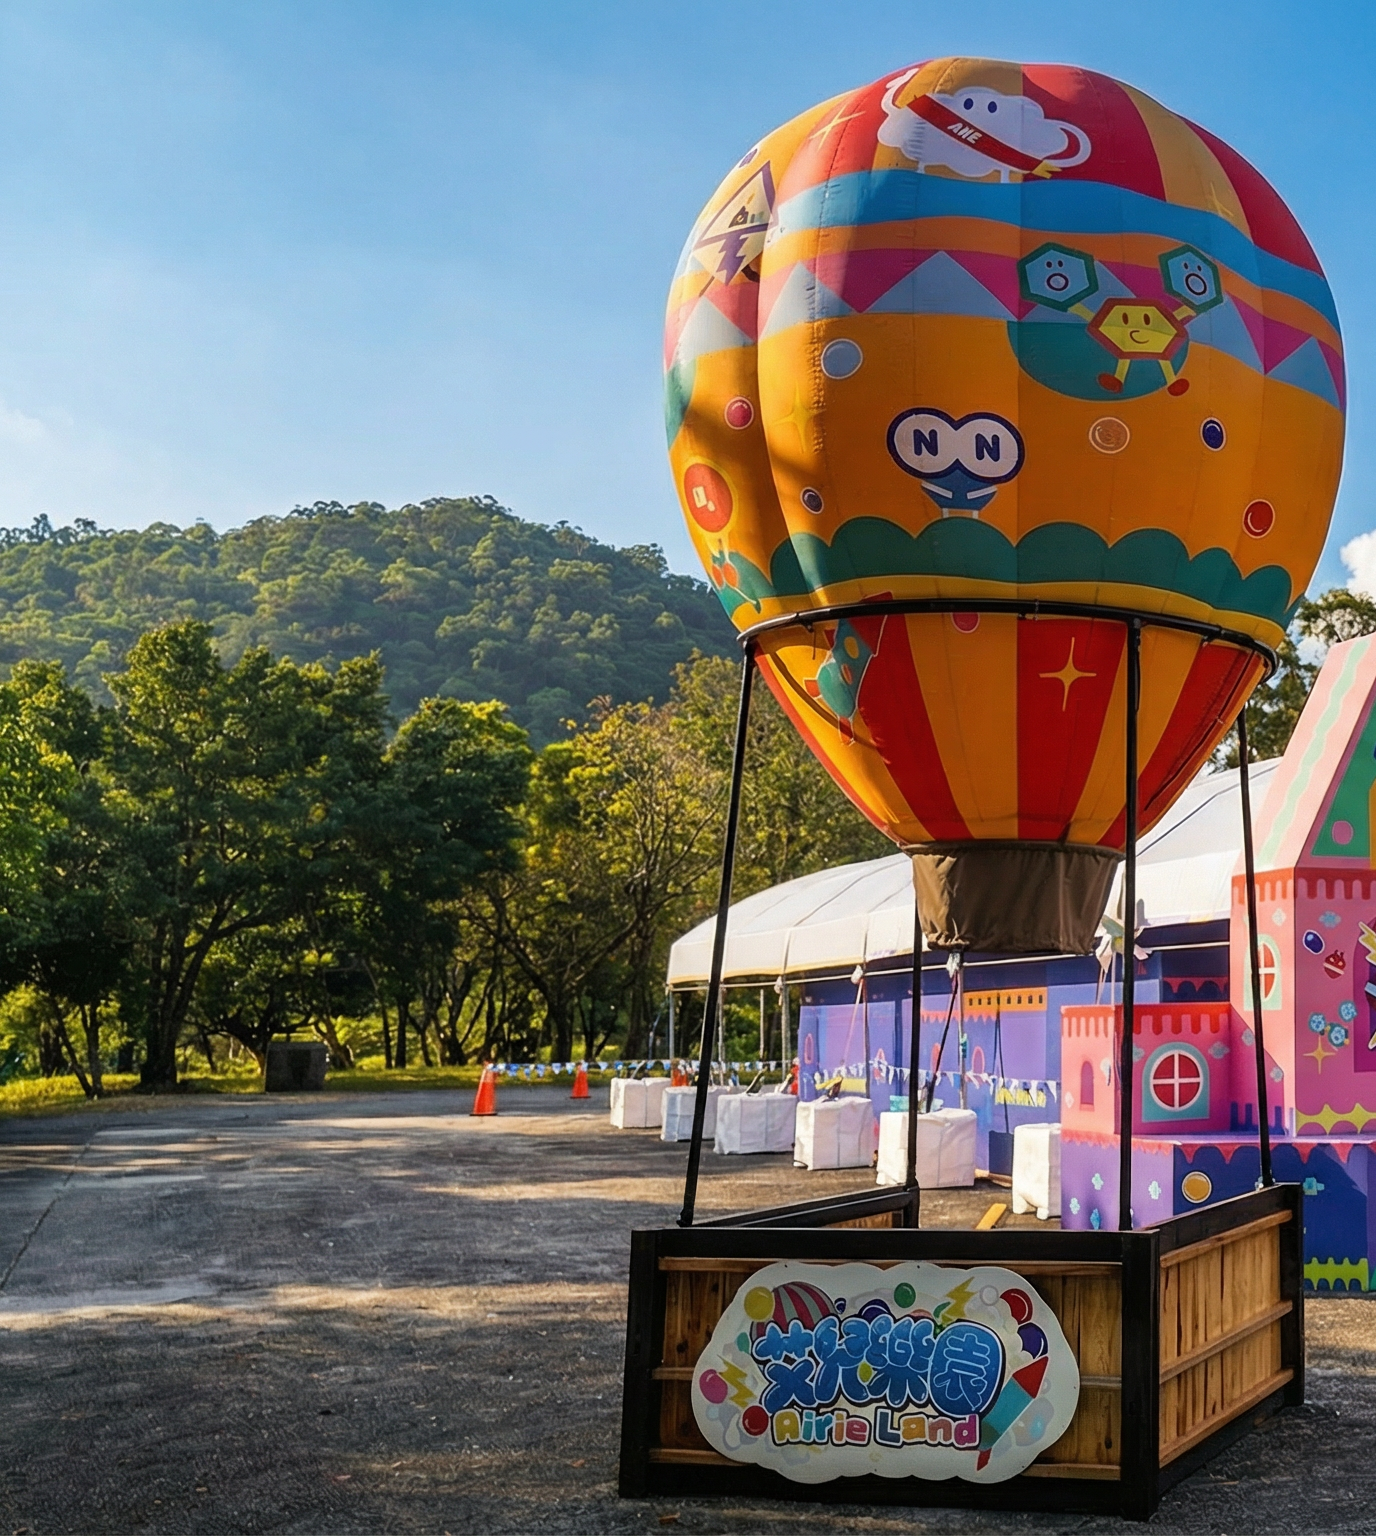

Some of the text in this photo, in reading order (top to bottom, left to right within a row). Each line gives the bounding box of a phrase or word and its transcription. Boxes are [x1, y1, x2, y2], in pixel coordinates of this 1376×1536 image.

[913, 429, 1000, 463] N N
[773, 1405, 980, 1448] Airie Land
